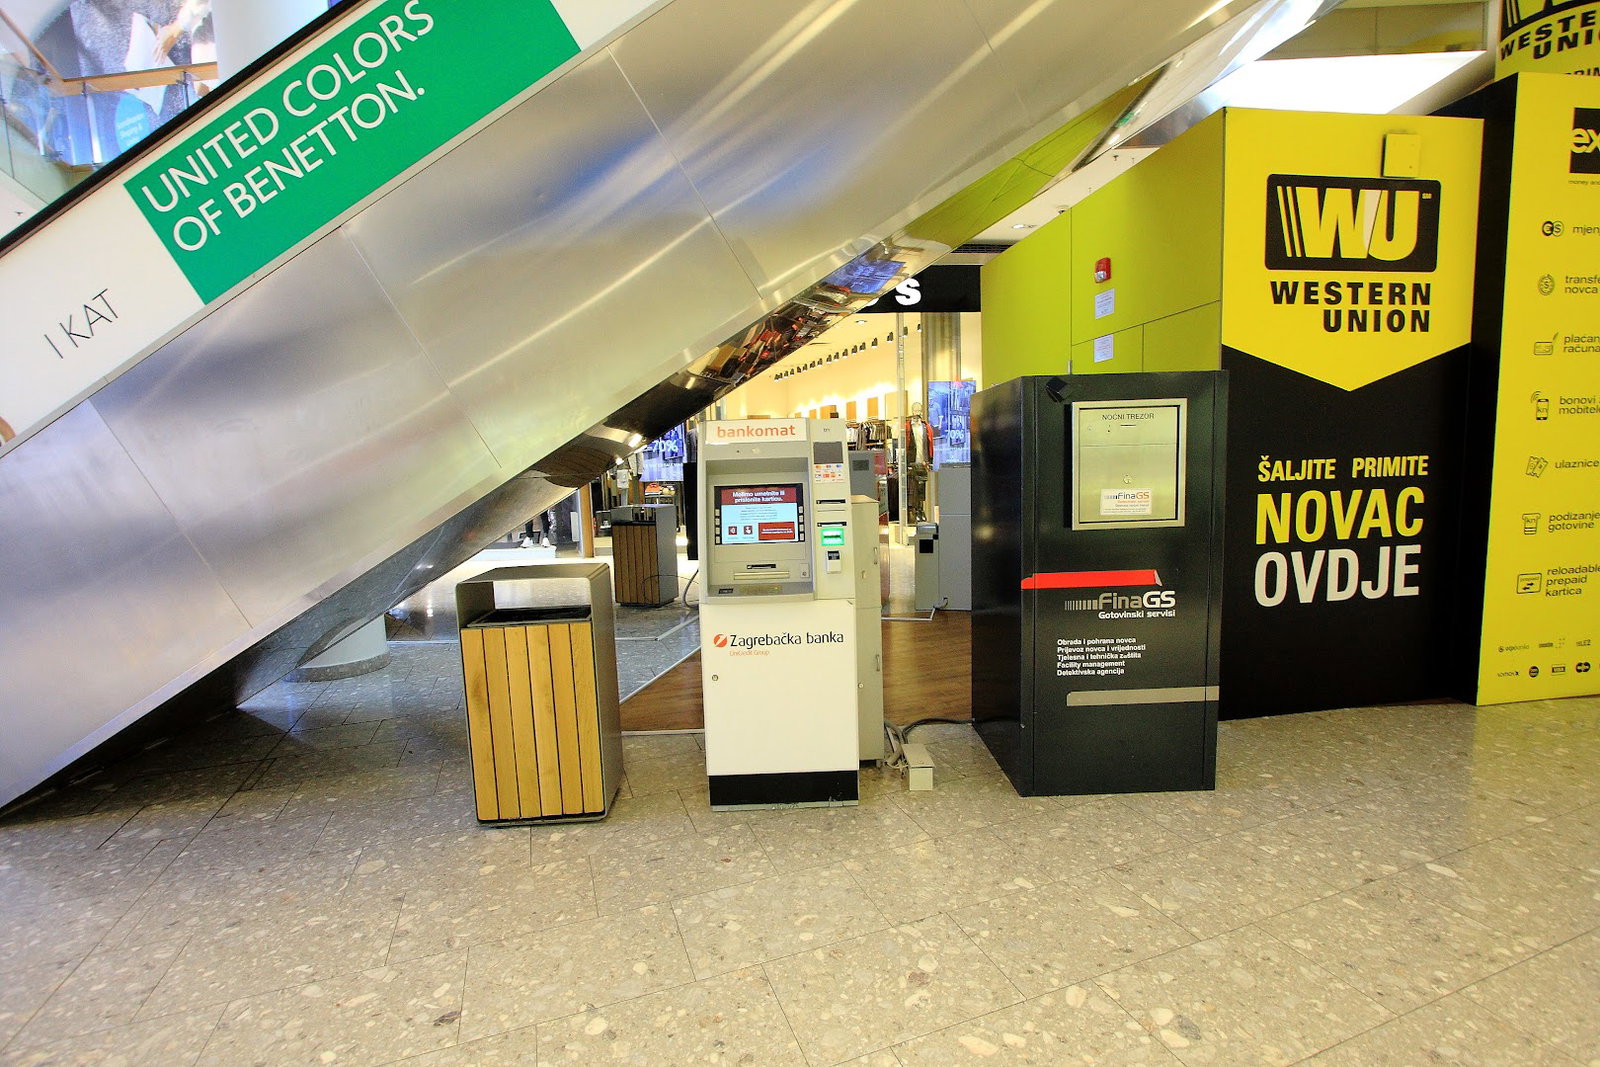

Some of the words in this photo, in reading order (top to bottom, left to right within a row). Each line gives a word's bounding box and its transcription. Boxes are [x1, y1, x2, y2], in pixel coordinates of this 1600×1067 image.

[1533, 29, 1600, 59] UNI
[142, 107, 279, 213] UNITED
[283, 0, 434, 117] COLORS
[173, 199, 222, 252] OF
[223, 70, 426, 219] BENETTON.
[1277, 185, 1420, 261] WU
[1270, 281, 1431, 305] WESTERN
[1564, 285, 1598, 294] novca
[59, 288, 118, 348] KAT
[1322, 309, 1431, 332] UNION
[1559, 395, 1596, 405] bonovi
[1126, 412, 1155, 420] TREZOR
[717, 425, 796, 438] bankomat
[1258, 455, 1337, 482] ŠALJITE
[1351, 455, 1430, 478] PRIMITE
[1554, 458, 1600, 469] ulaznice
[1117, 491, 1150, 500] FinaGS
[1255, 486, 1425, 545] NOVAC
[1548, 511, 1600, 523] podizanje
[1548, 521, 1595, 533] gotovine
[1254, 544, 1421, 608] OVDJE
[1545, 574, 1587, 587] prepaid
[1098, 590, 1176, 610] FinaGS
[1545, 587, 1582, 597] kartica
[1098, 611, 1144, 620] Gotovinski
[1146, 610, 1176, 618] servisi
[730, 632, 802, 650] Zagrebačka
[806, 631, 844, 644] banka
[1082, 660, 1125, 669] management
